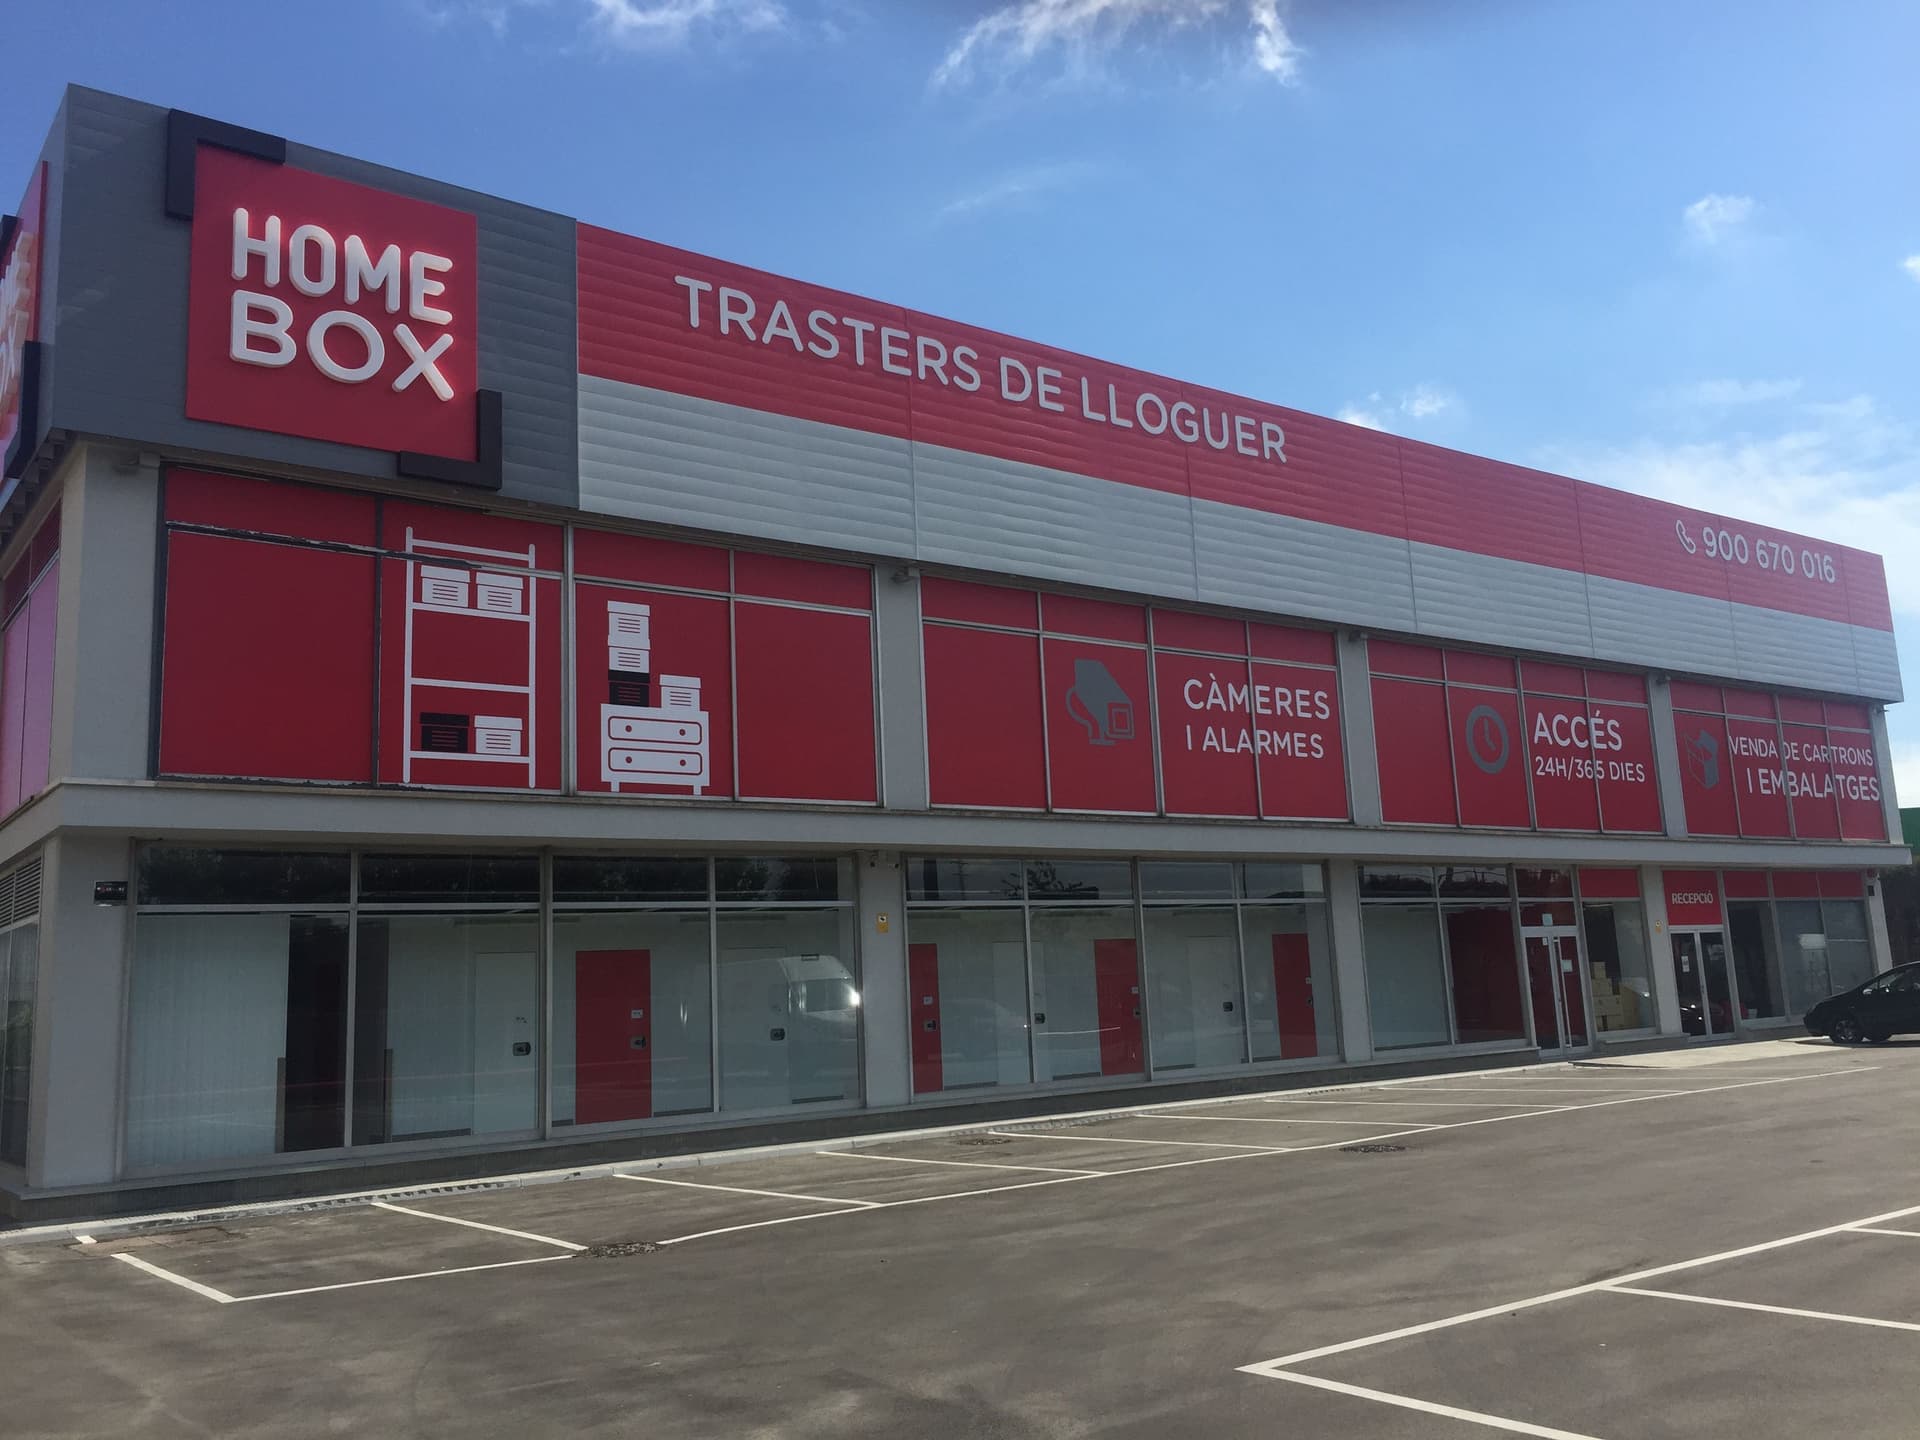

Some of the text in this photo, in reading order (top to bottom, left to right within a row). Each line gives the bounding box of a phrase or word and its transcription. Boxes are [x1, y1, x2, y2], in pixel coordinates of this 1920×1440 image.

[232, 207, 453, 325] HOME
[230, 289, 454, 401] BOX
[675, 275, 1287, 463] TRASTERS DE LLOGUER
[1702, 526, 1836, 584] 900 670 016
[1184, 672, 1330, 720] CÀMERES
[1186, 724, 1324, 759] I ALARMES
[1534, 710, 1622, 751] ACCÉS
[1728, 735, 1874, 767] VENDA DE CARTRONS
[1535, 756, 1646, 782] 24H/365 DIES
[1746, 768, 1880, 801] I EMBALATGES
[1671, 890, 1714, 904] RECEPCIÓ
